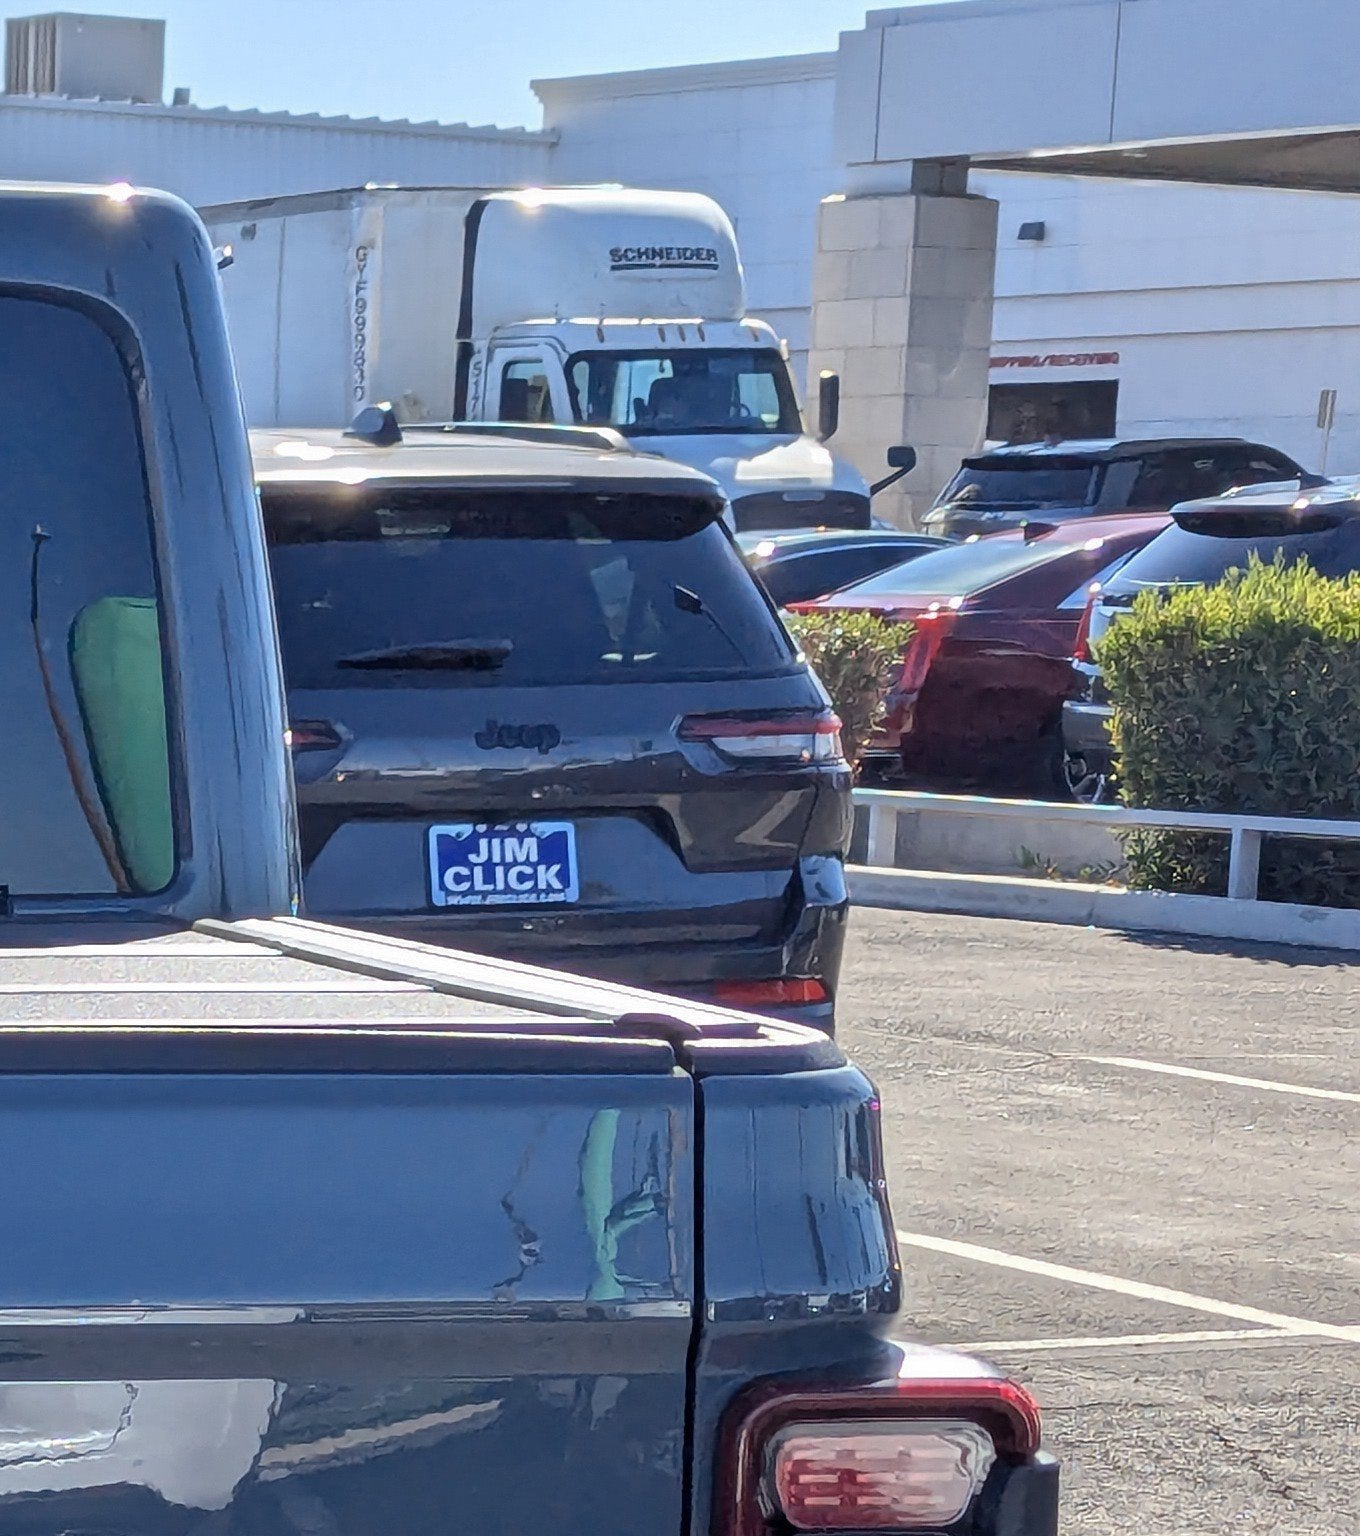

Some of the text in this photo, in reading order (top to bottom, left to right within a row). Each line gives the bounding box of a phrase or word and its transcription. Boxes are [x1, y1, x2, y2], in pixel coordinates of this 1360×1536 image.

[609, 246, 718, 263] SCHNEIDER
[467, 836, 539, 864] JIM
[443, 863, 564, 892] CLICK
